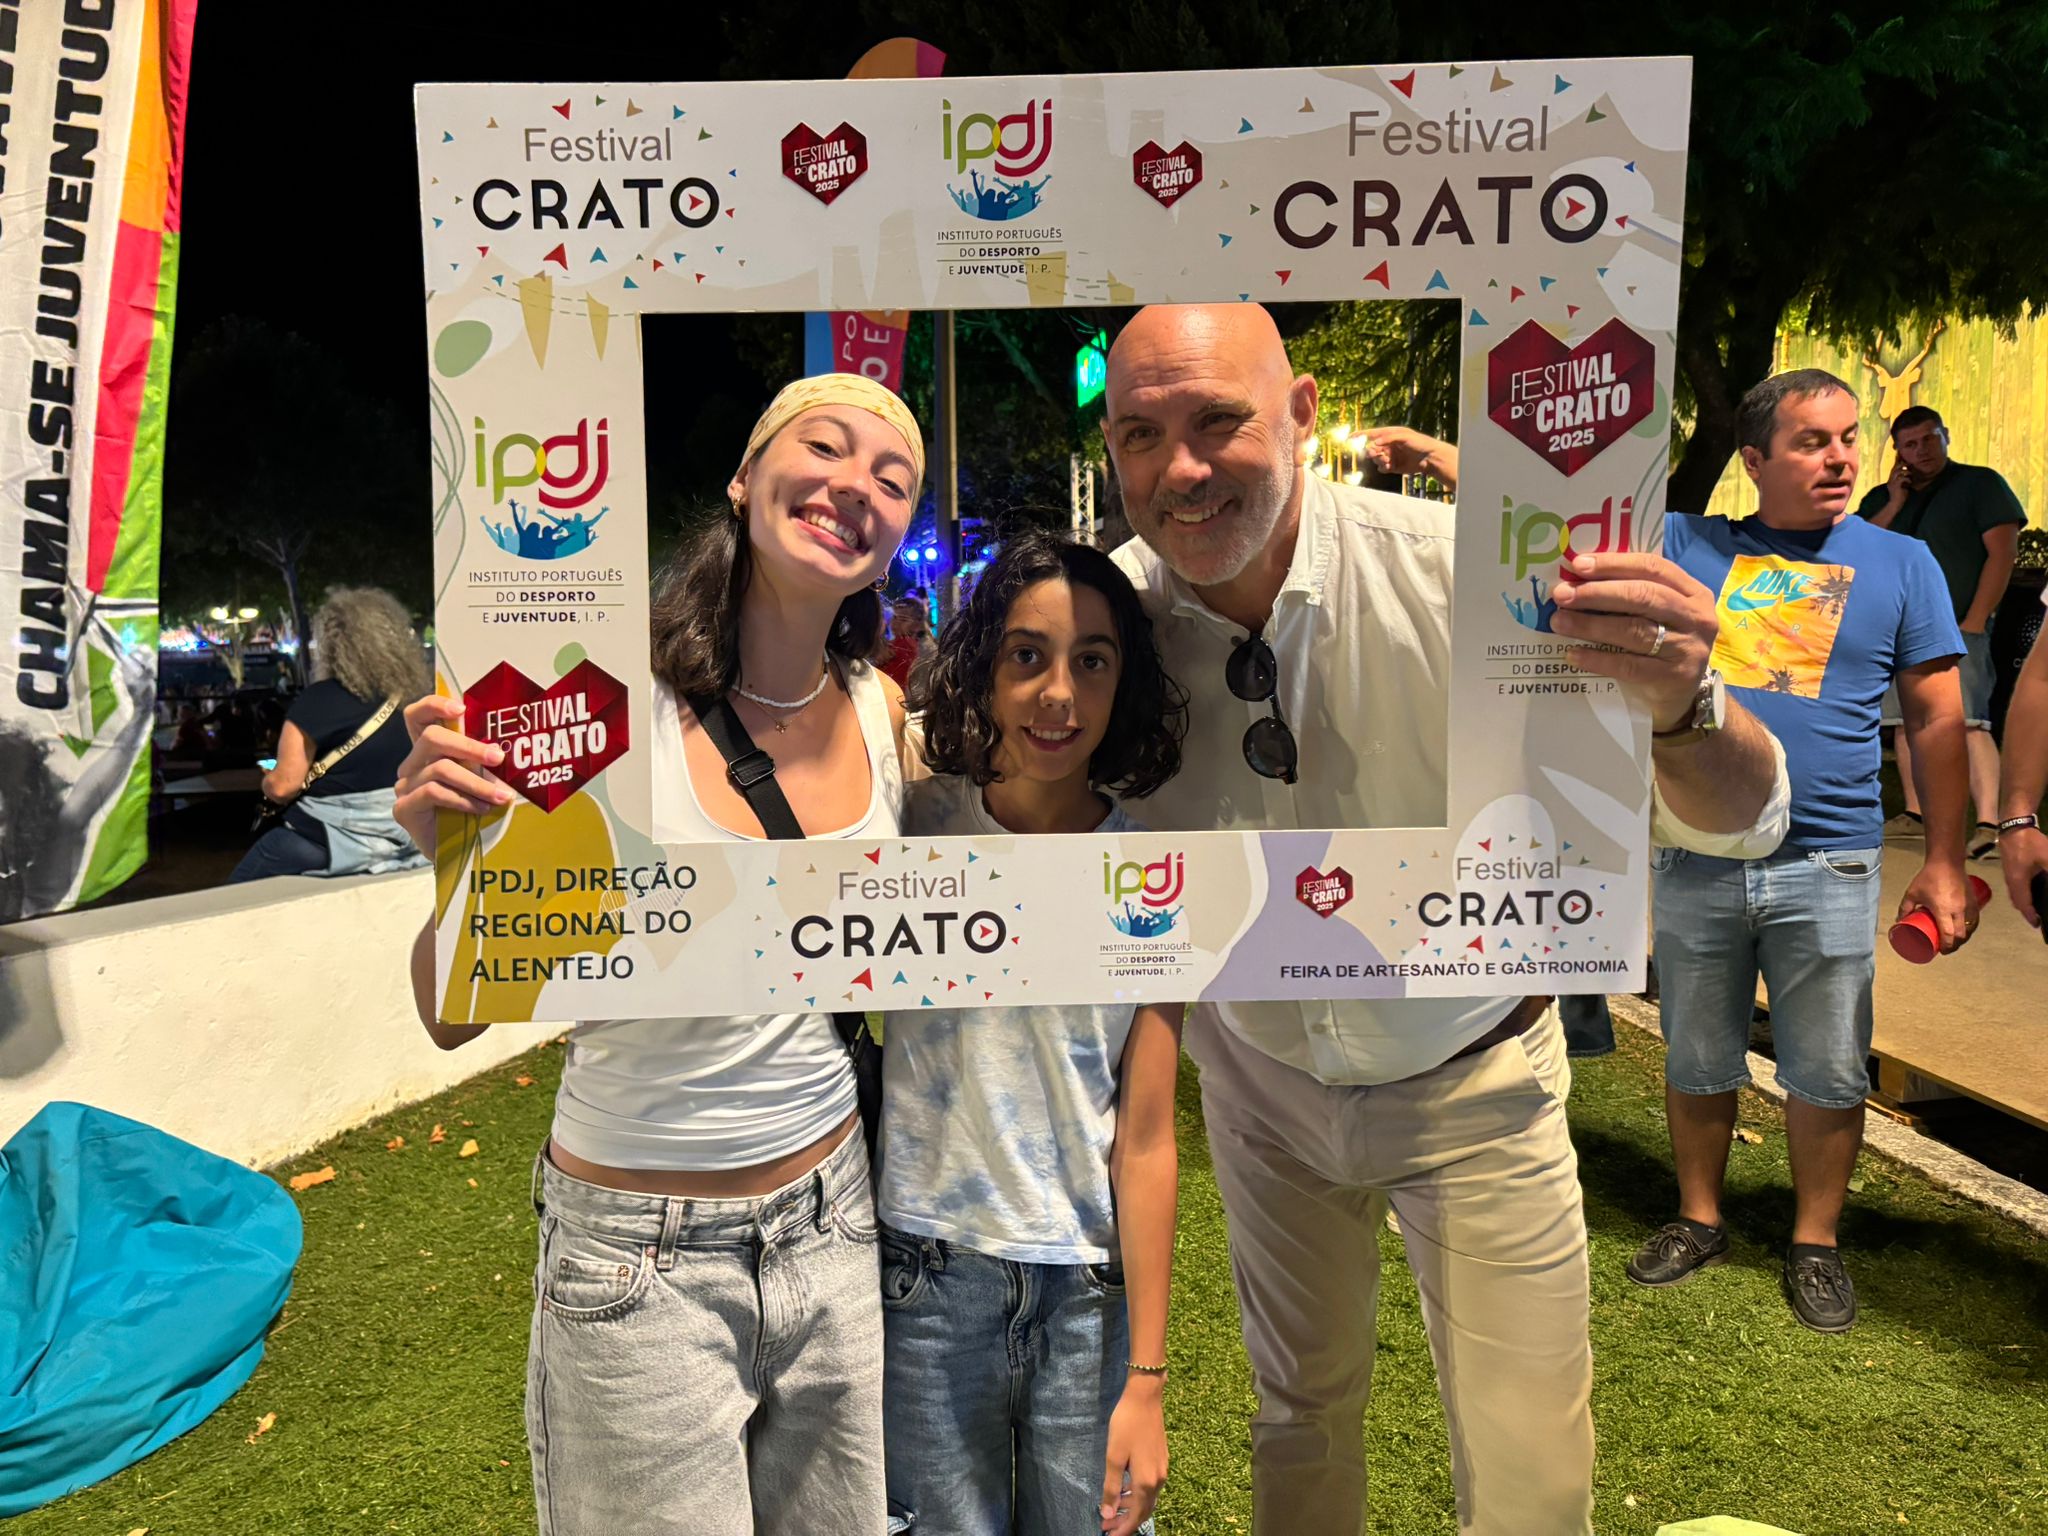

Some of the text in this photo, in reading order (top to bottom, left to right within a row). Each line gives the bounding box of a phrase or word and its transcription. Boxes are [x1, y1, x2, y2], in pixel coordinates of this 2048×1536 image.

[943, 99, 1052, 177] ipdj
[1348, 105, 1548, 156] Festival
[524, 127, 672, 162] Festival
[793, 139, 848, 166] FESTIVAL
[808, 155, 856, 182] CRATO
[1142, 155, 1187, 175] FESTIVAL
[815, 179, 839, 192] 2025
[1152, 168, 1193, 189] CRATO
[473, 177, 719, 230] CRATO
[1158, 187, 1178, 198] 2025
[1273, 173, 1608, 249] CRATO
[937, 227, 1062, 240] INSTITUTO PORTUGUÊS
[959, 247, 1040, 257] DO DESPORTO
[949, 266, 954, 275] E
[957, 264, 1027, 276] JUVENTUDE,
[1512, 352, 1616, 402] FESTIVAL
[1511, 382, 1631, 433] DO CRATO
[1549, 428, 1595, 453] 2025
[474, 416, 609, 509] ipdj
[17, 360, 75, 710] CHAMA-SE
[469, 568, 623, 582] INSTITUTO PORTUGUÊS
[1745, 569, 1816, 595] NIKE
[496, 591, 596, 602] DO DESPORTO
[483, 612, 489, 623] E
[493, 611, 581, 624] JUVENTUDE,
[1487, 644, 1552, 656] INSTITUTO
[1512, 664, 1588, 675] DO DESPO
[1499, 684, 1504, 694] E
[1508, 683, 1591, 695] JUVENTUDE,
[374, 701, 395, 724] TOUS
[487, 692, 592, 740] FESTIVAL
[336, 733, 362, 756] TOUS
[513, 721, 607, 769] CRATO
[527, 764, 574, 788] 2025
[470, 861, 697, 899] IPDJ, DIREÇÃO
[1104, 851, 1184, 907] ipdj
[1457, 856, 1561, 881] Festival
[839, 869, 966, 900] Festival
[1303, 877, 1341, 894] FESTIVAL
[1312, 887, 1346, 904] CRATO
[1418, 889, 1593, 928] CRATO
[470, 910, 692, 938] REGIONAL DO
[791, 910, 1007, 959] CRATO
[1100, 942, 1192, 952] INSTITUTO PORTUGUÊS
[1116, 955, 1176, 964] DO DESPORTO
[469, 955, 634, 982] ALENTEJO
[1280, 959, 1629, 979] FEIRA DE ARTESANATO E GASTRONOMIA
